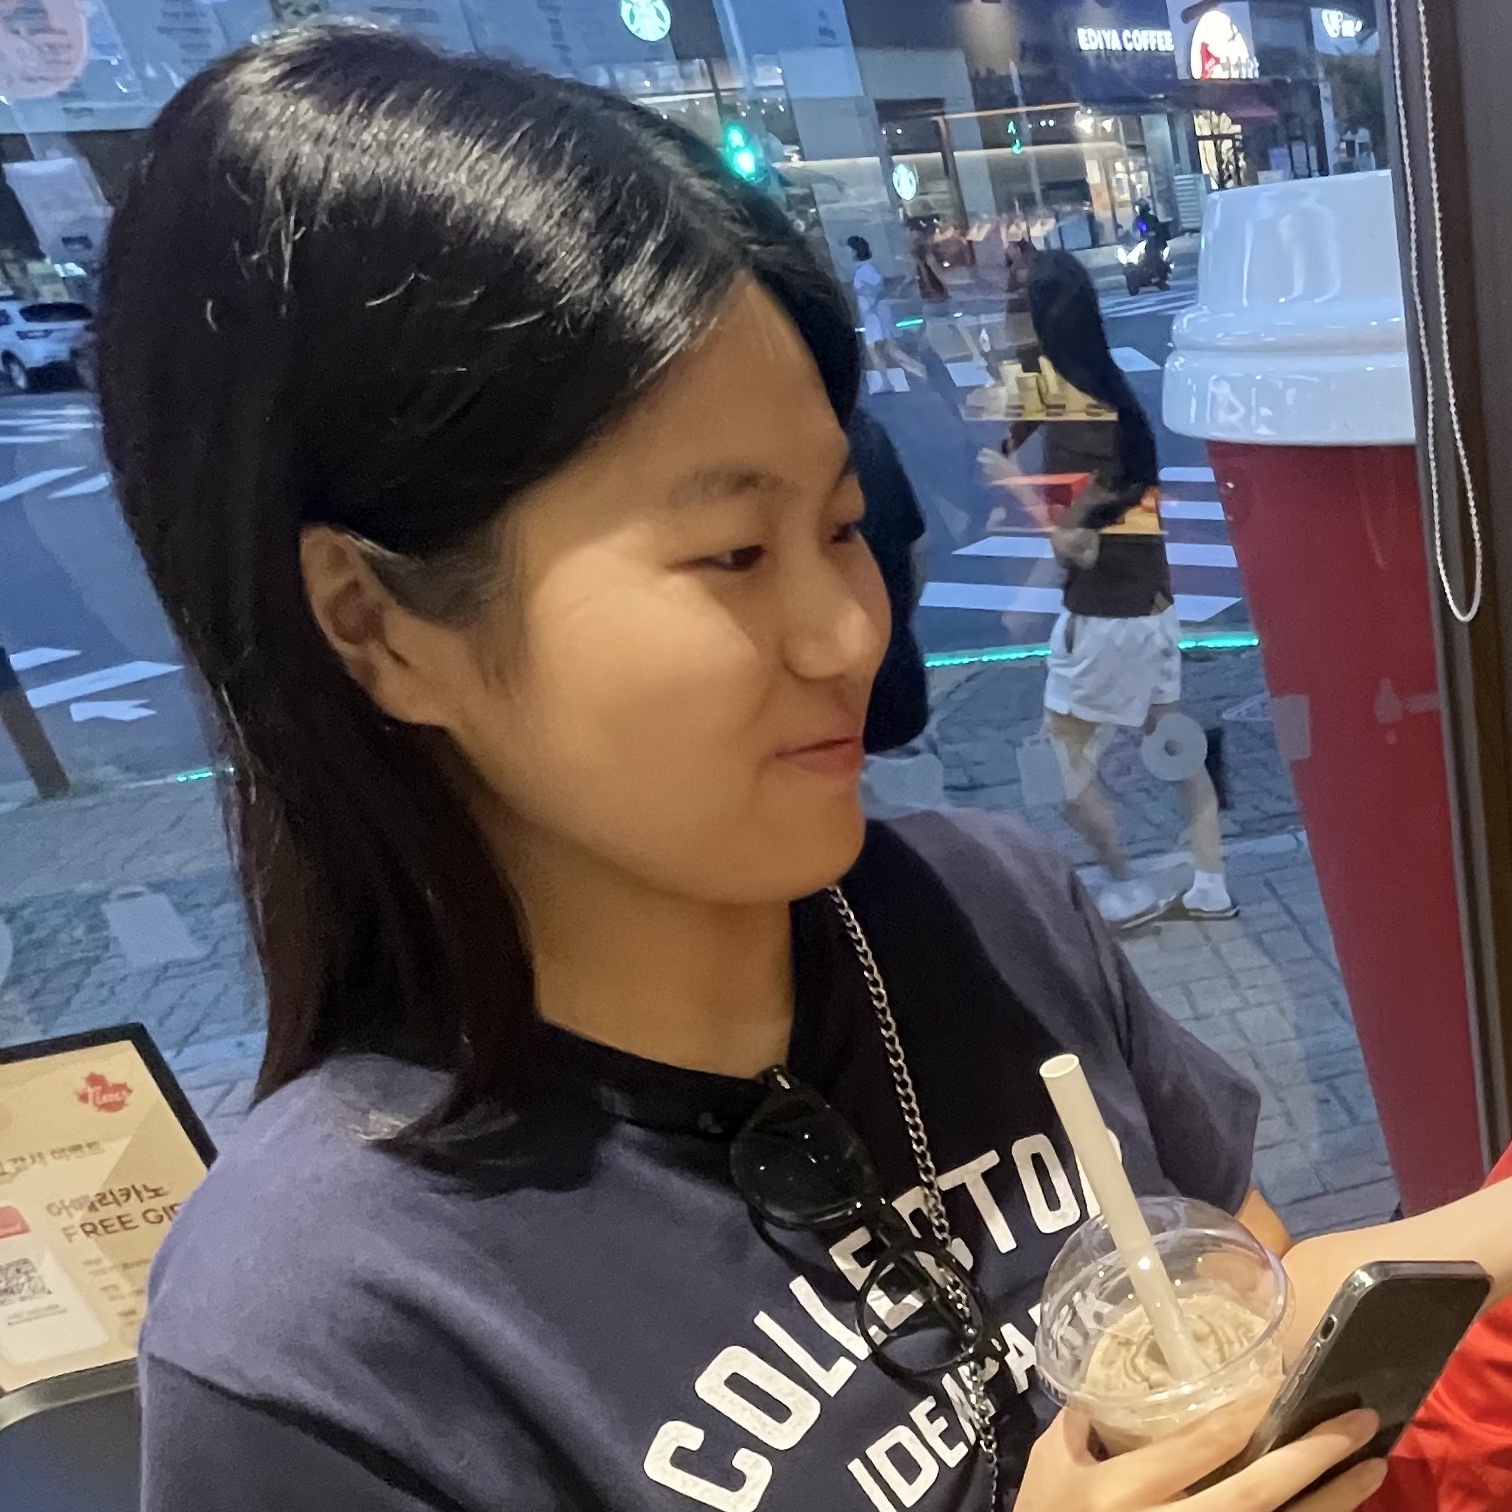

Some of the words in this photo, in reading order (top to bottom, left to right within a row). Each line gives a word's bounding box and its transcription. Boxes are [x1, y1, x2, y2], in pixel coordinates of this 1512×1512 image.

[1077, 27, 1122, 51] EDIYA
[1121, 28, 1175, 52] COFFEE
[61, 1212, 139, 1244] FREE
